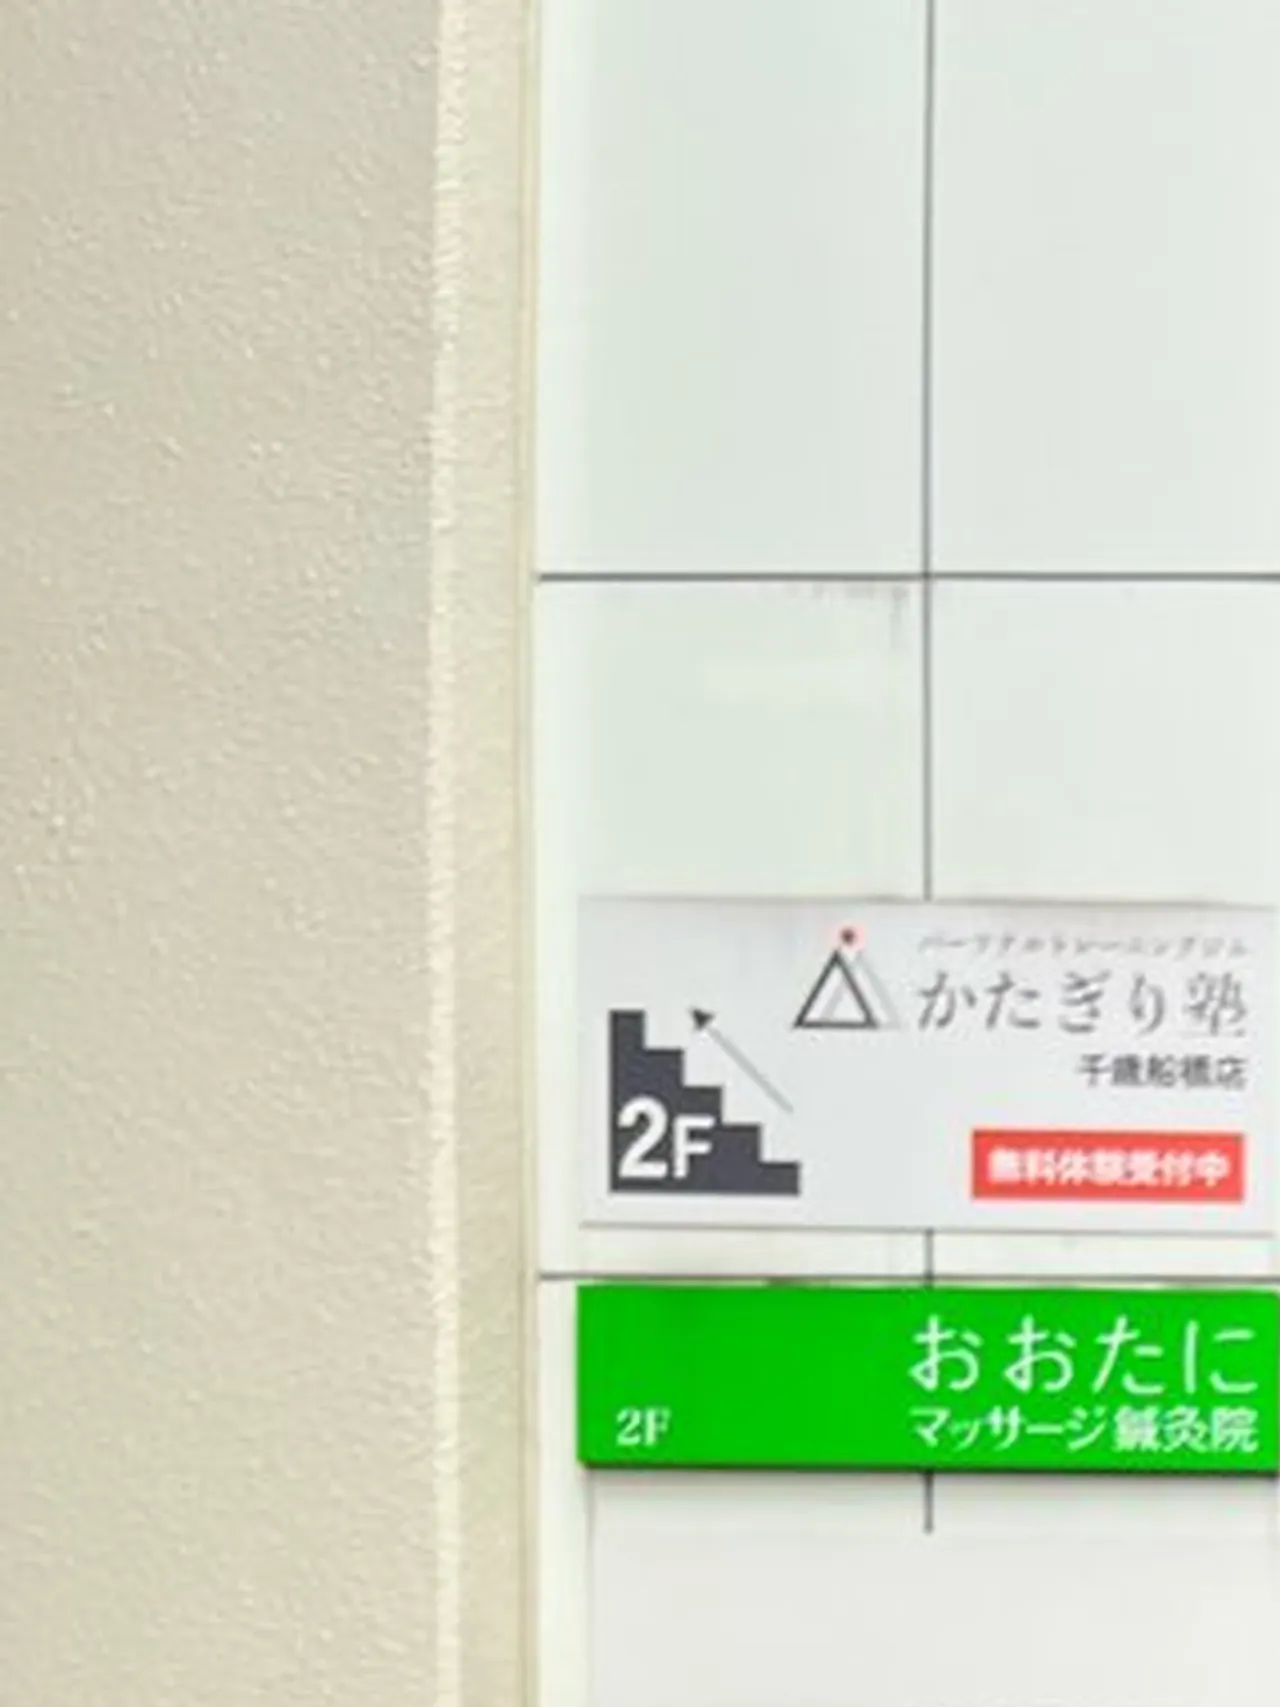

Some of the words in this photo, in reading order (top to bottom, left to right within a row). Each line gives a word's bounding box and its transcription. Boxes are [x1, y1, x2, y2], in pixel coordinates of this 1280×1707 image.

[917, 970, 1247, 1036] かたぎり塾
[618, 1096, 714, 1180] 2F
[909, 1314, 1258, 1395] おおたに
[616, 1407, 671, 1447] 2F
[910, 1404, 1260, 1453] マッサージ鍼灸院
